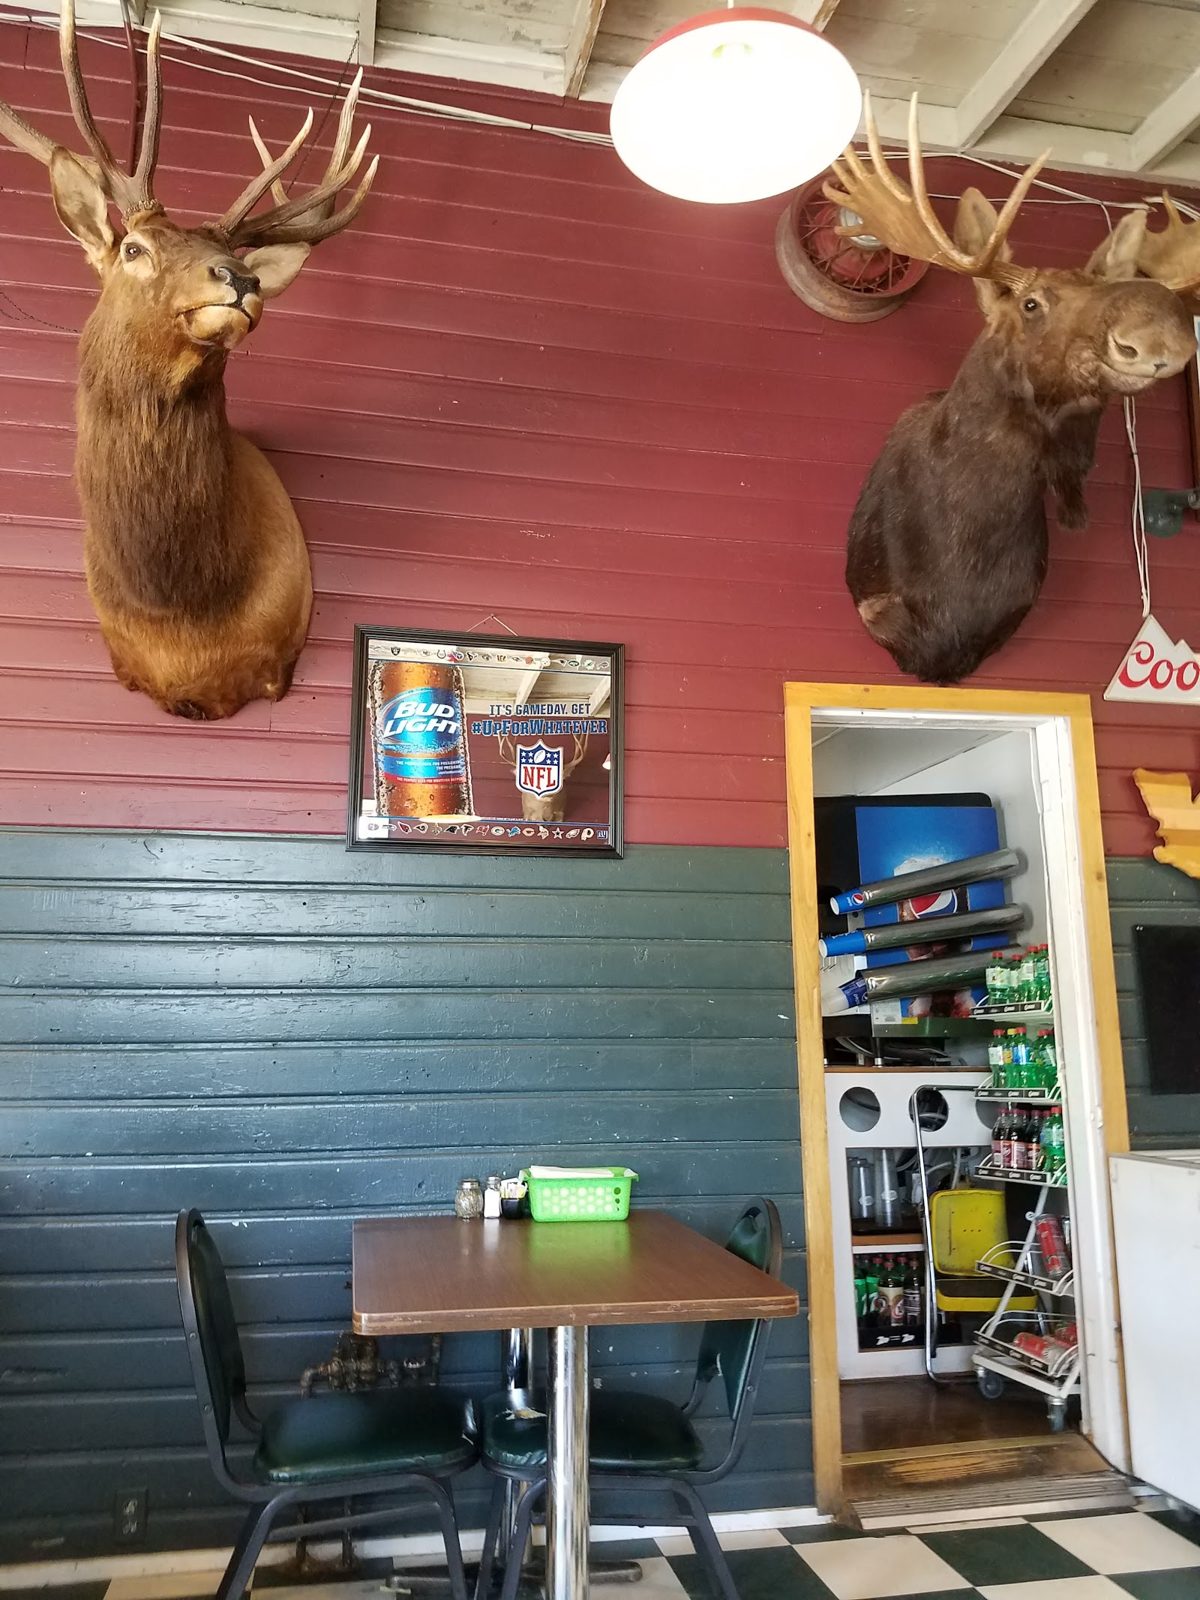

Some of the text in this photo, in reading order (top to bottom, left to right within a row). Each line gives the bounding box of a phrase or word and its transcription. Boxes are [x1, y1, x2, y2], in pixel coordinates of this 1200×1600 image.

[489, 703, 591, 716] IT'S GAMEDAY. GET
[523, 766, 556, 790] NFL
